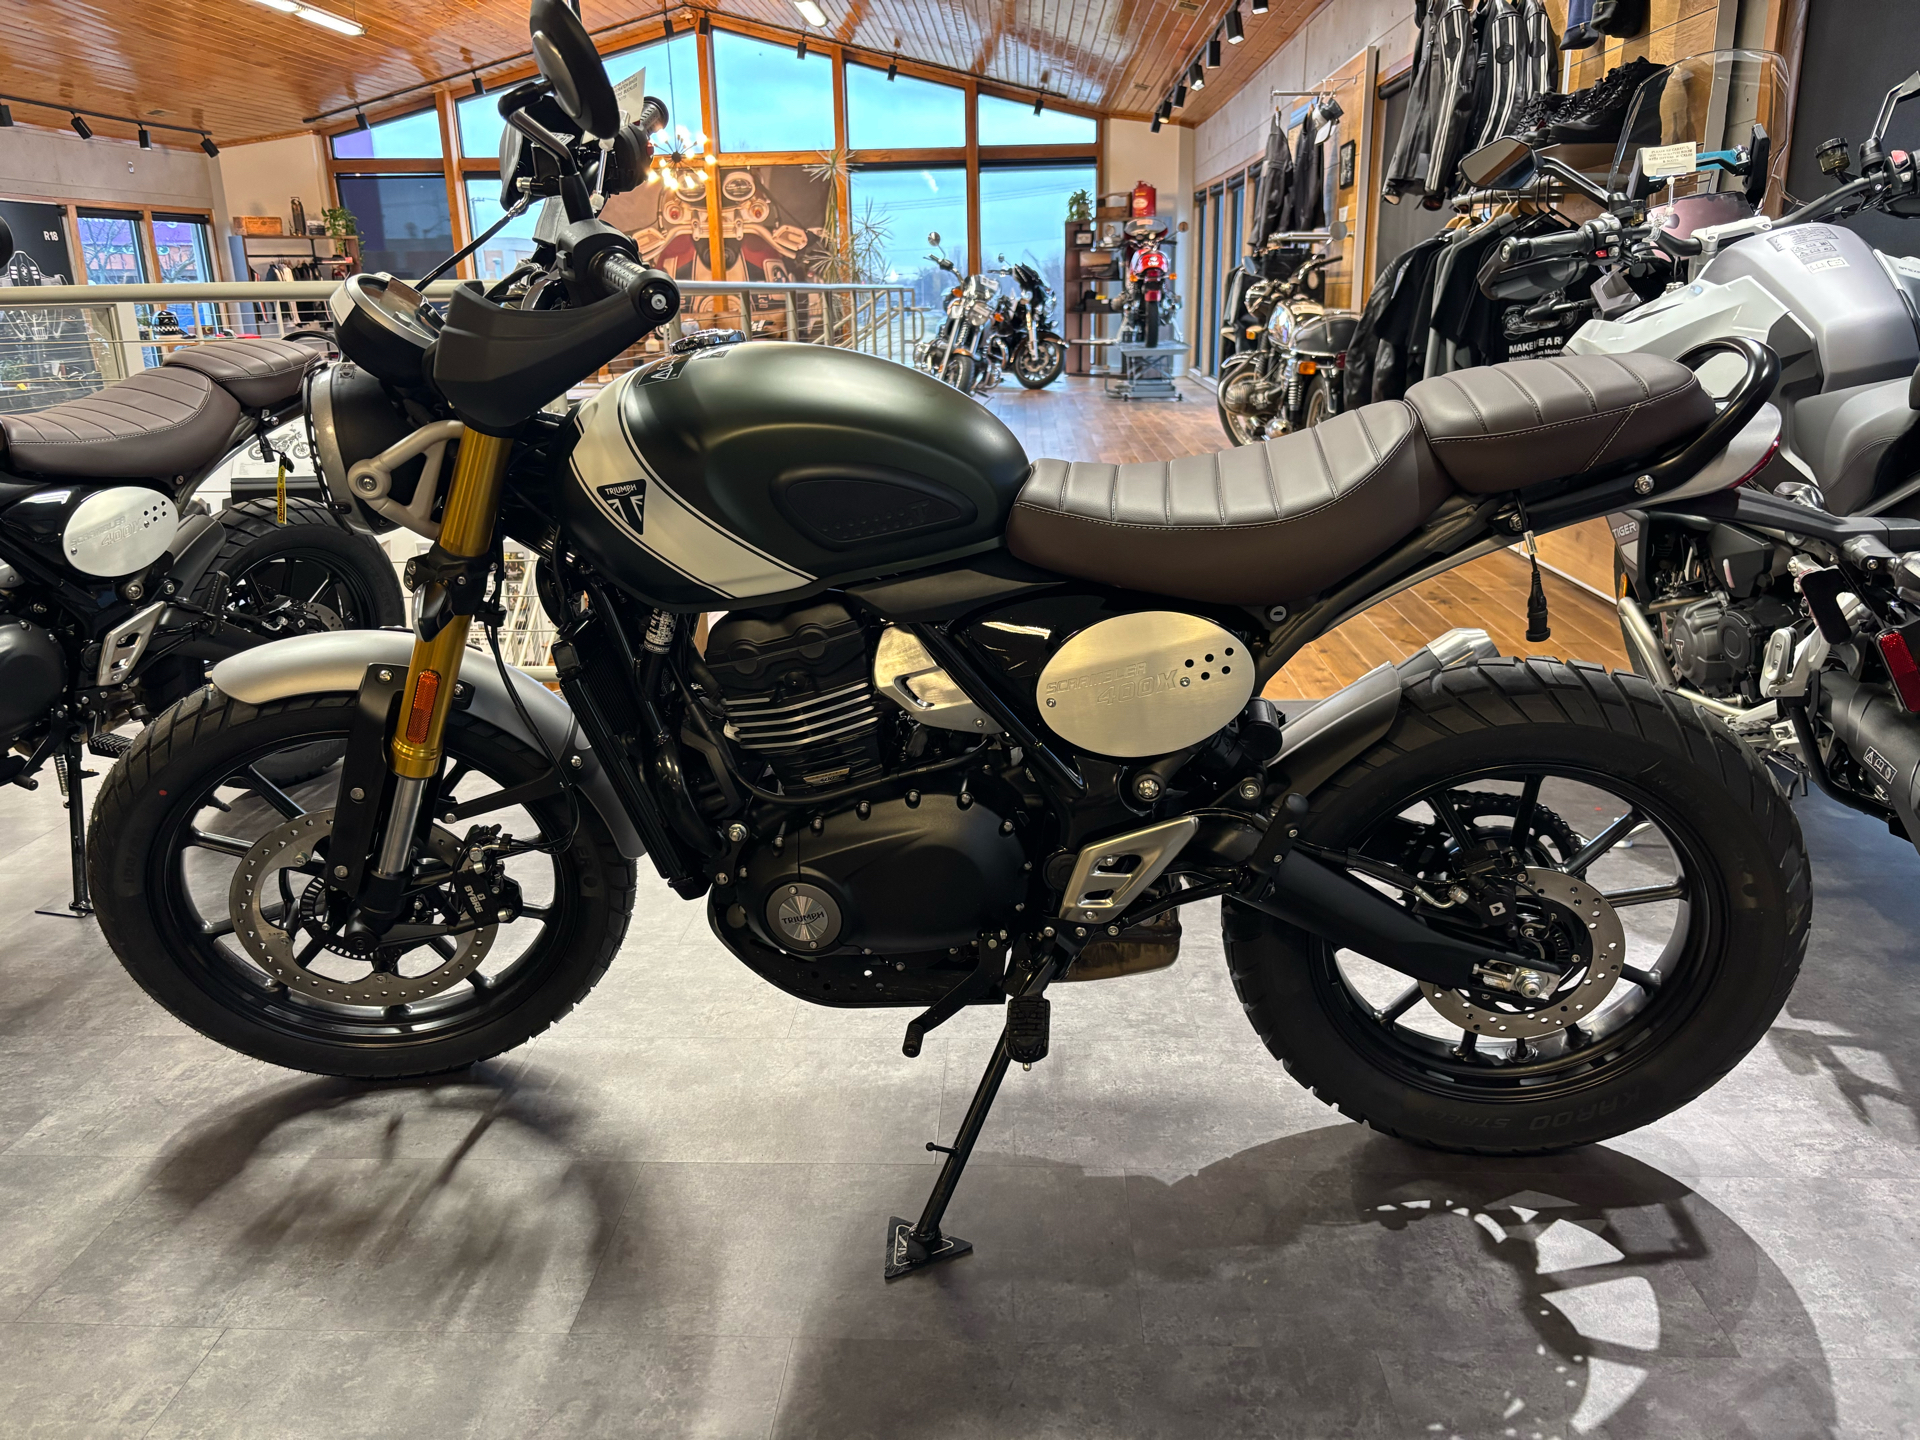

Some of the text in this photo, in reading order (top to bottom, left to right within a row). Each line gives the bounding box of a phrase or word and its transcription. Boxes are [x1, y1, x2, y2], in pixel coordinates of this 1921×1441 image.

[43, 231, 59, 242] R18
[1508, 341, 1534, 355] MAKE
[604, 484, 638, 496] TRIUMPH
[1611, 521, 1637, 539] TIGER
[1045, 660, 1147, 696] SCRAMBLER
[1096, 668, 1179, 707] 400X
[463, 884, 484, 914] BYBRE
[780, 911, 825, 925] TRIUMPH
